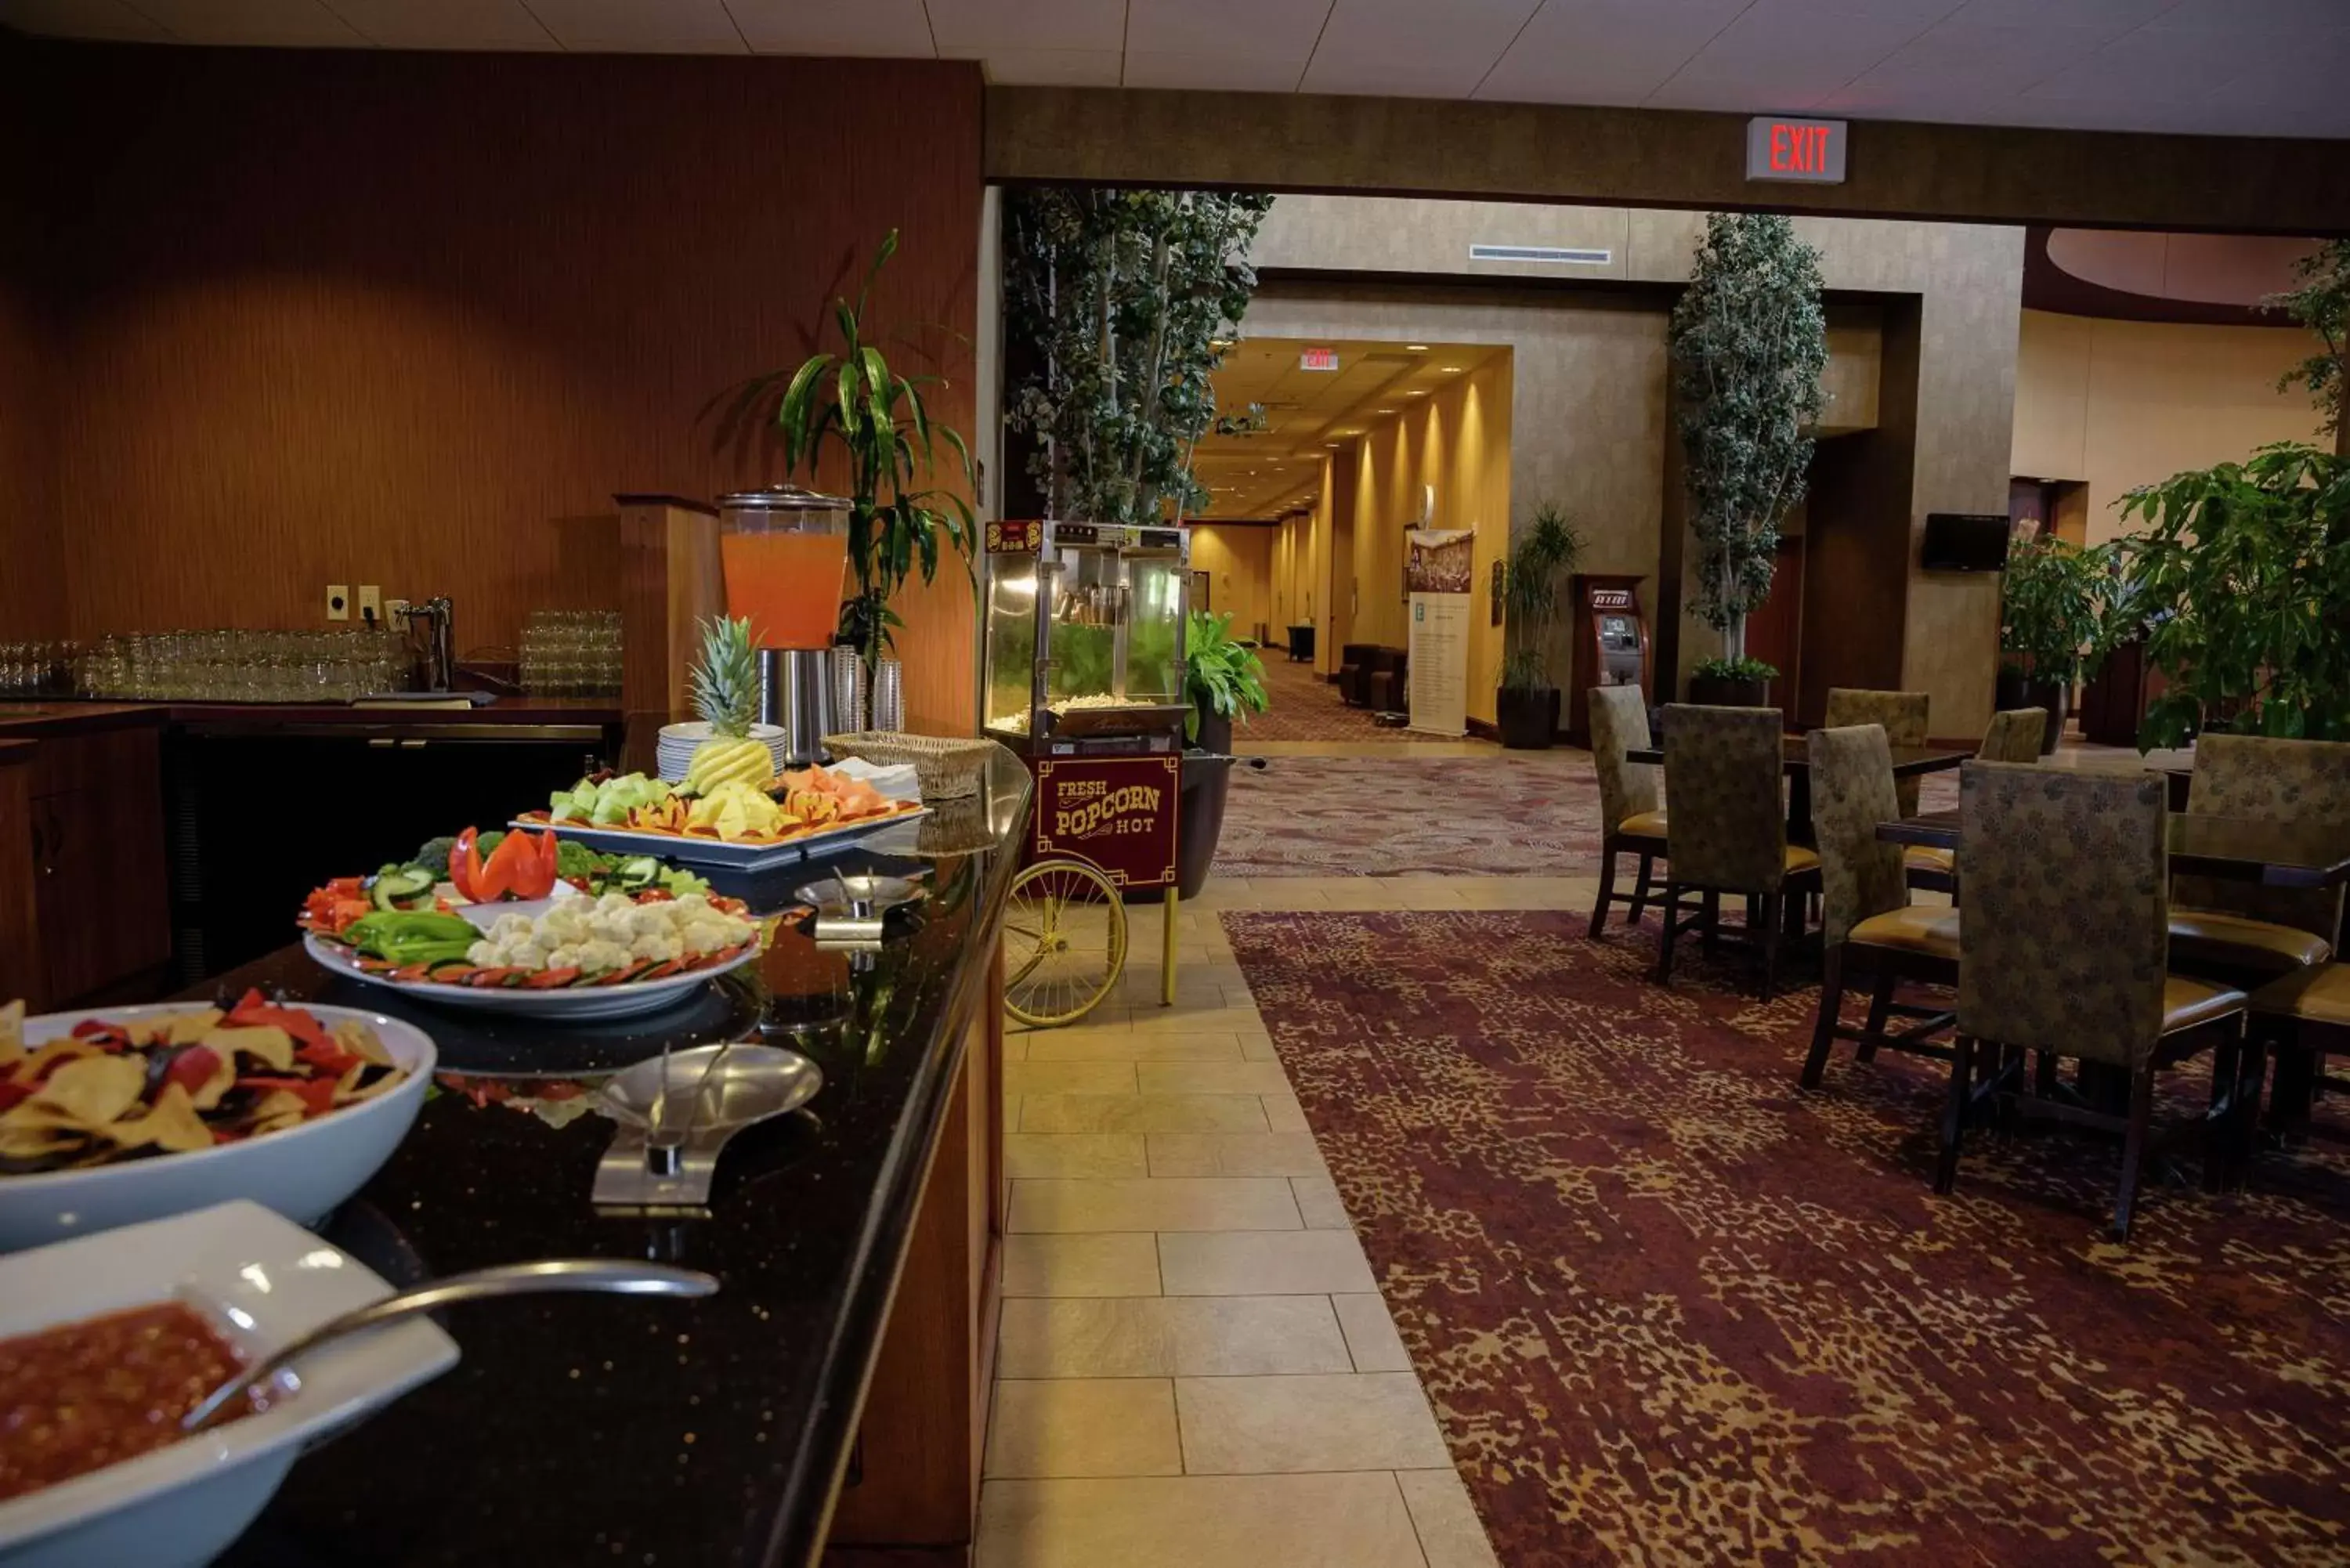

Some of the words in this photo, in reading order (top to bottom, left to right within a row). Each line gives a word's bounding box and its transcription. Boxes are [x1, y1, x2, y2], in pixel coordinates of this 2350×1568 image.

[1770, 124, 1830, 173] EXIT
[1595, 595, 1627, 605] ATM
[1058, 781, 1107, 797] FRESH
[1056, 786, 1160, 835] POPCORN
[1116, 818, 1154, 834] HOT
